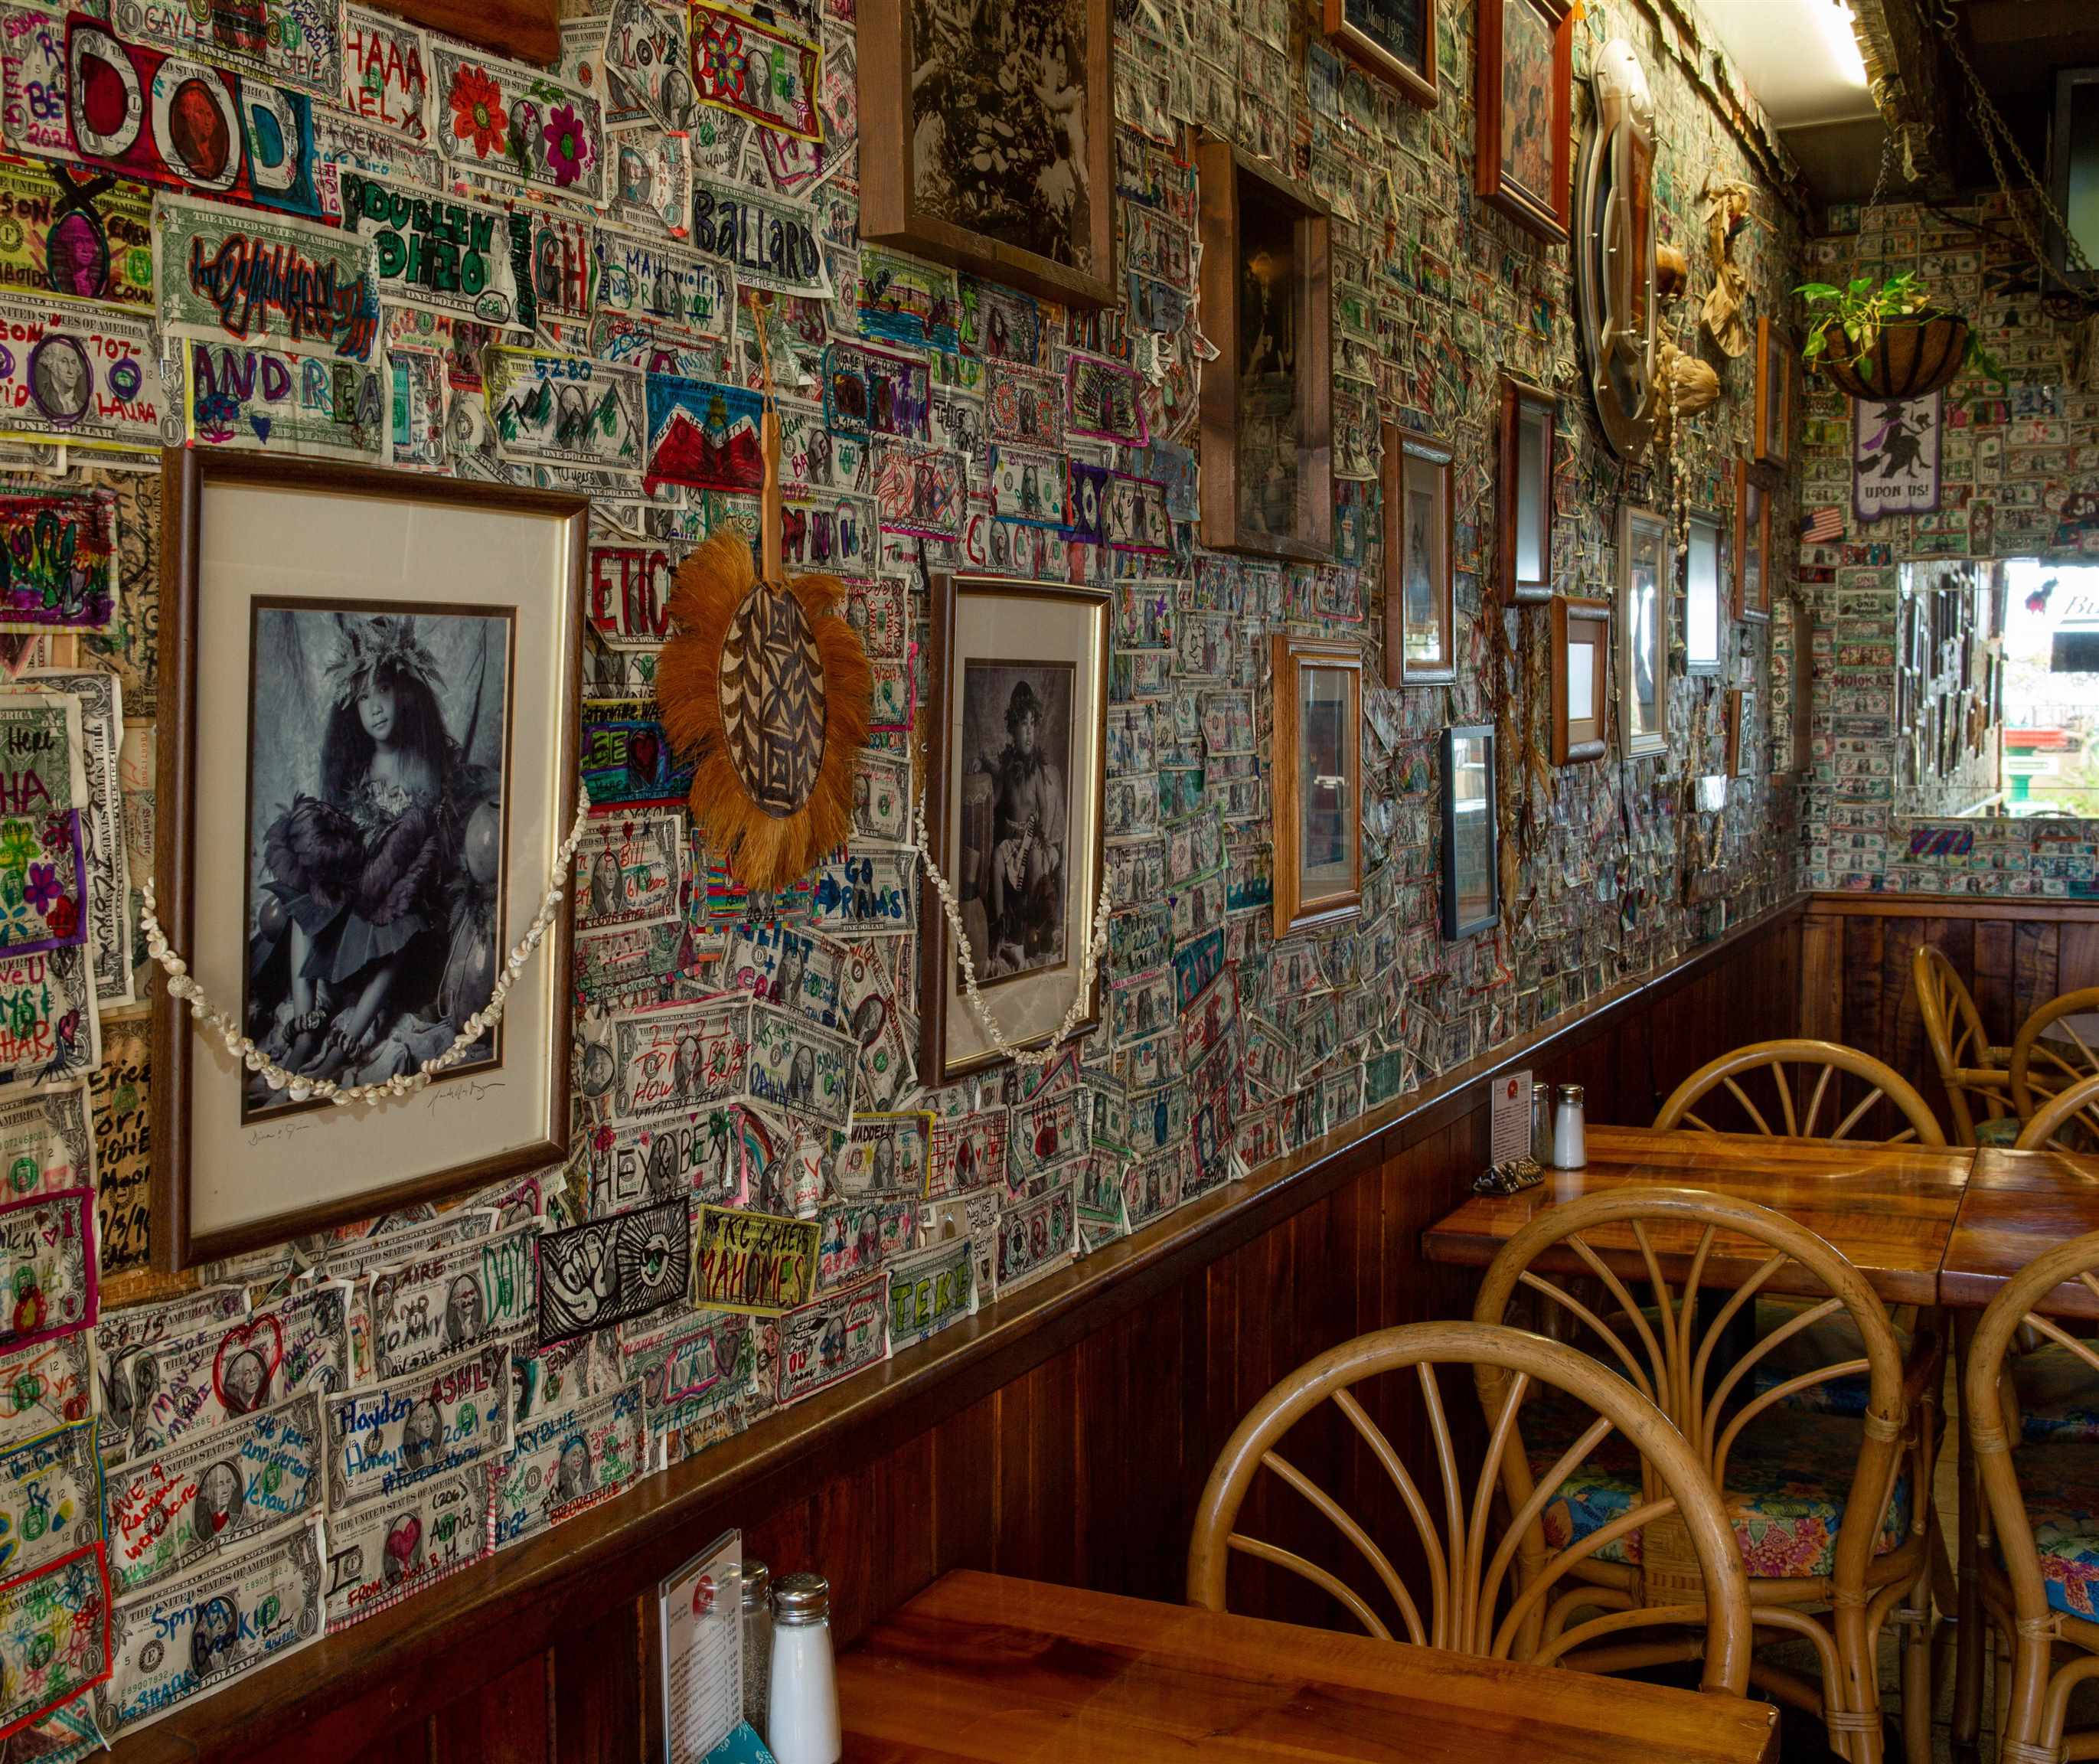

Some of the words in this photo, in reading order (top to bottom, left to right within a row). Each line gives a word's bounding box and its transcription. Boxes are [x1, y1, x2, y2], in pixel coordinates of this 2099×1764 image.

[1366, 5, 1385, 34] Maui
[1387, 18, 1405, 47] 1995
[619, 25, 677, 70] LOVE
[193, 211, 218, 225] THE
[219, 214, 259, 231] UNITED
[99, 321, 144, 336] AMERICA
[193, 345, 381, 426] ANDREA
[14, 420, 50, 432] ONE
[96, 392, 157, 426] LAURA
[1865, 484, 1902, 498] UPON
[1908, 483, 1929, 498] US!
[845, 856, 873, 884] GO
[651, 1015, 731, 1047] 2021
[595, 1148, 651, 1204] HEX
[680, 1121, 728, 1175] BEX
[697, 1246, 806, 1305] MAHOMES
[431, 1341, 511, 1403] ASHLEY
[340, 1390, 413, 1436] Hayden
[429, 1507, 476, 1548] Anna
[205, 1657, 256, 1686] DOLLAR
